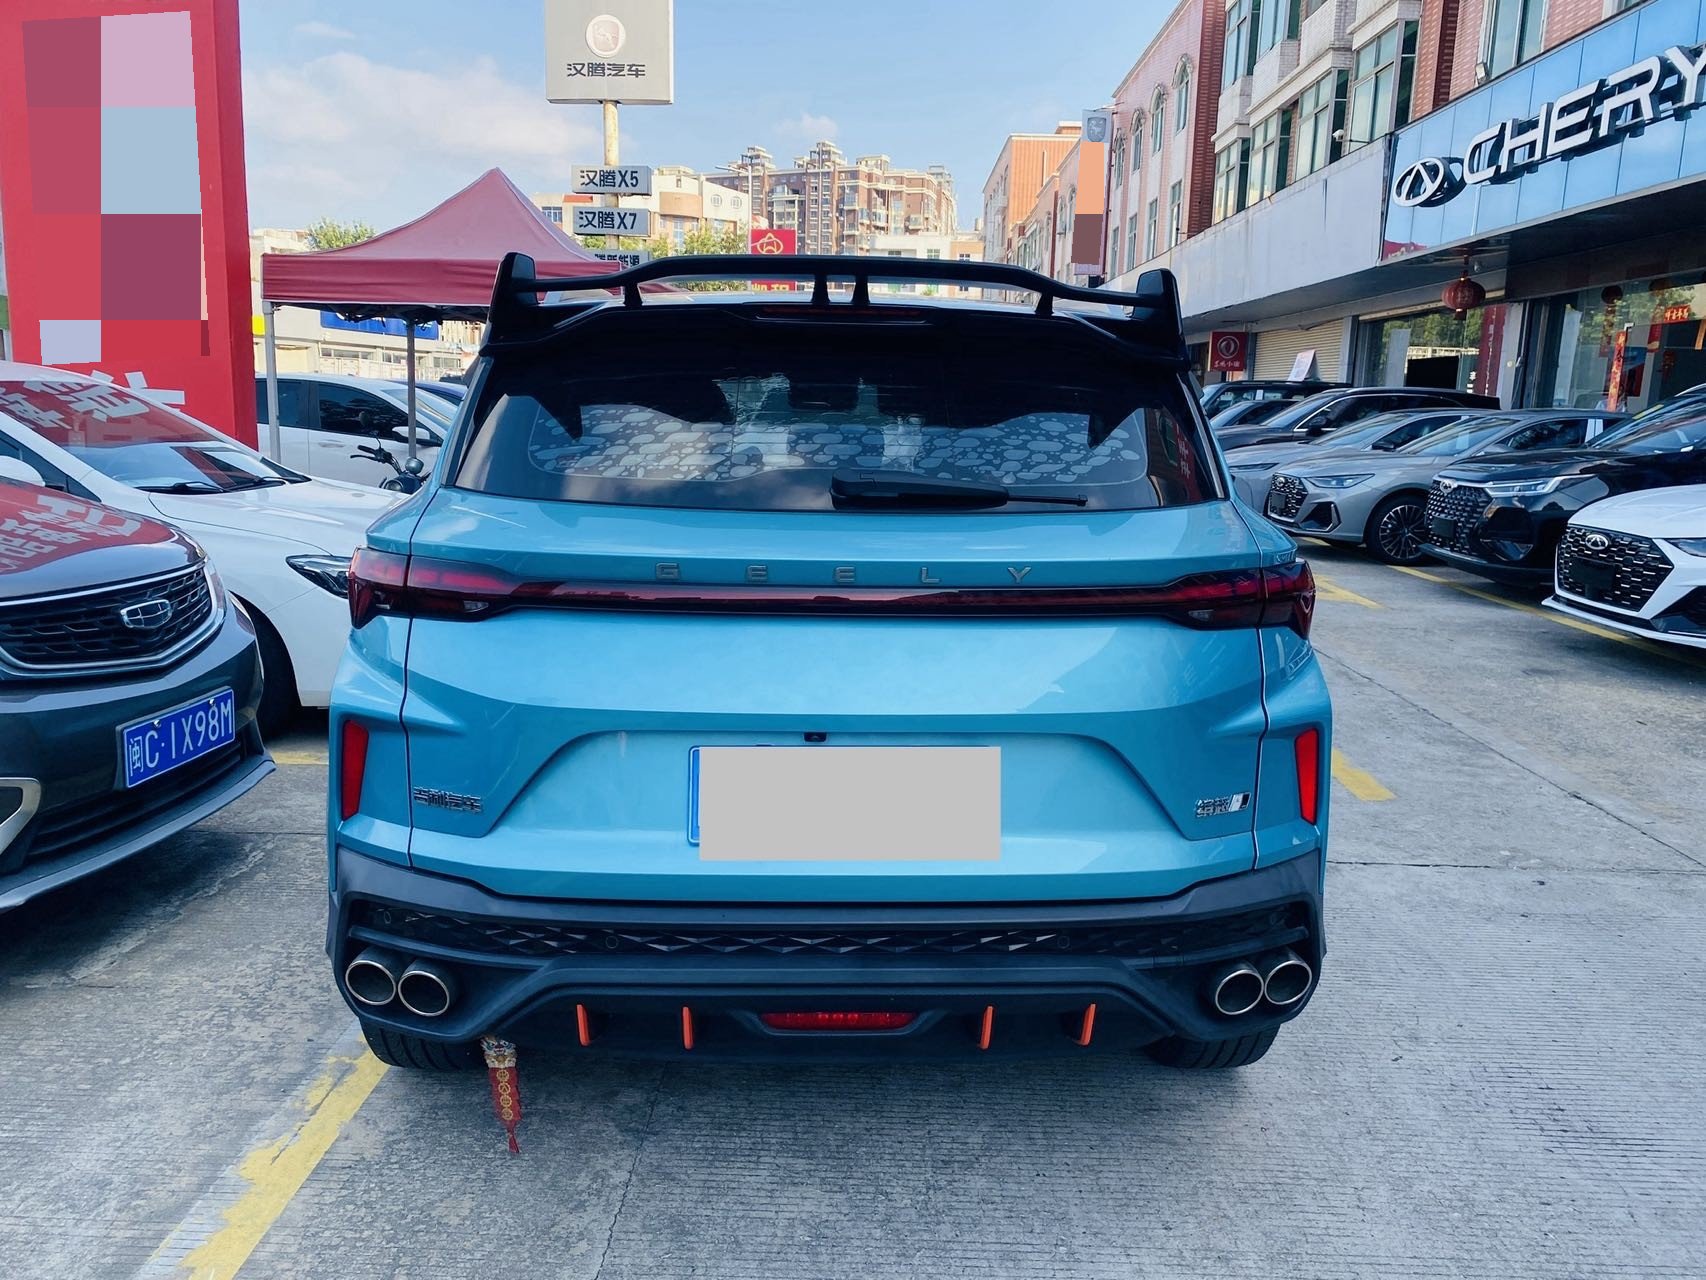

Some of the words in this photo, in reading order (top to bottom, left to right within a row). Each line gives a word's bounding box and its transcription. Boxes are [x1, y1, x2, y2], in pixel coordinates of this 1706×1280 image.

[566, 62, 646, 78] 汉腾汽车
[1463, 45, 1706, 185] CHERY
[579, 169, 639, 188] 汉腾X5
[578, 210, 637, 230] 汉腾X7
[655, 562, 1032, 584] GEELY
